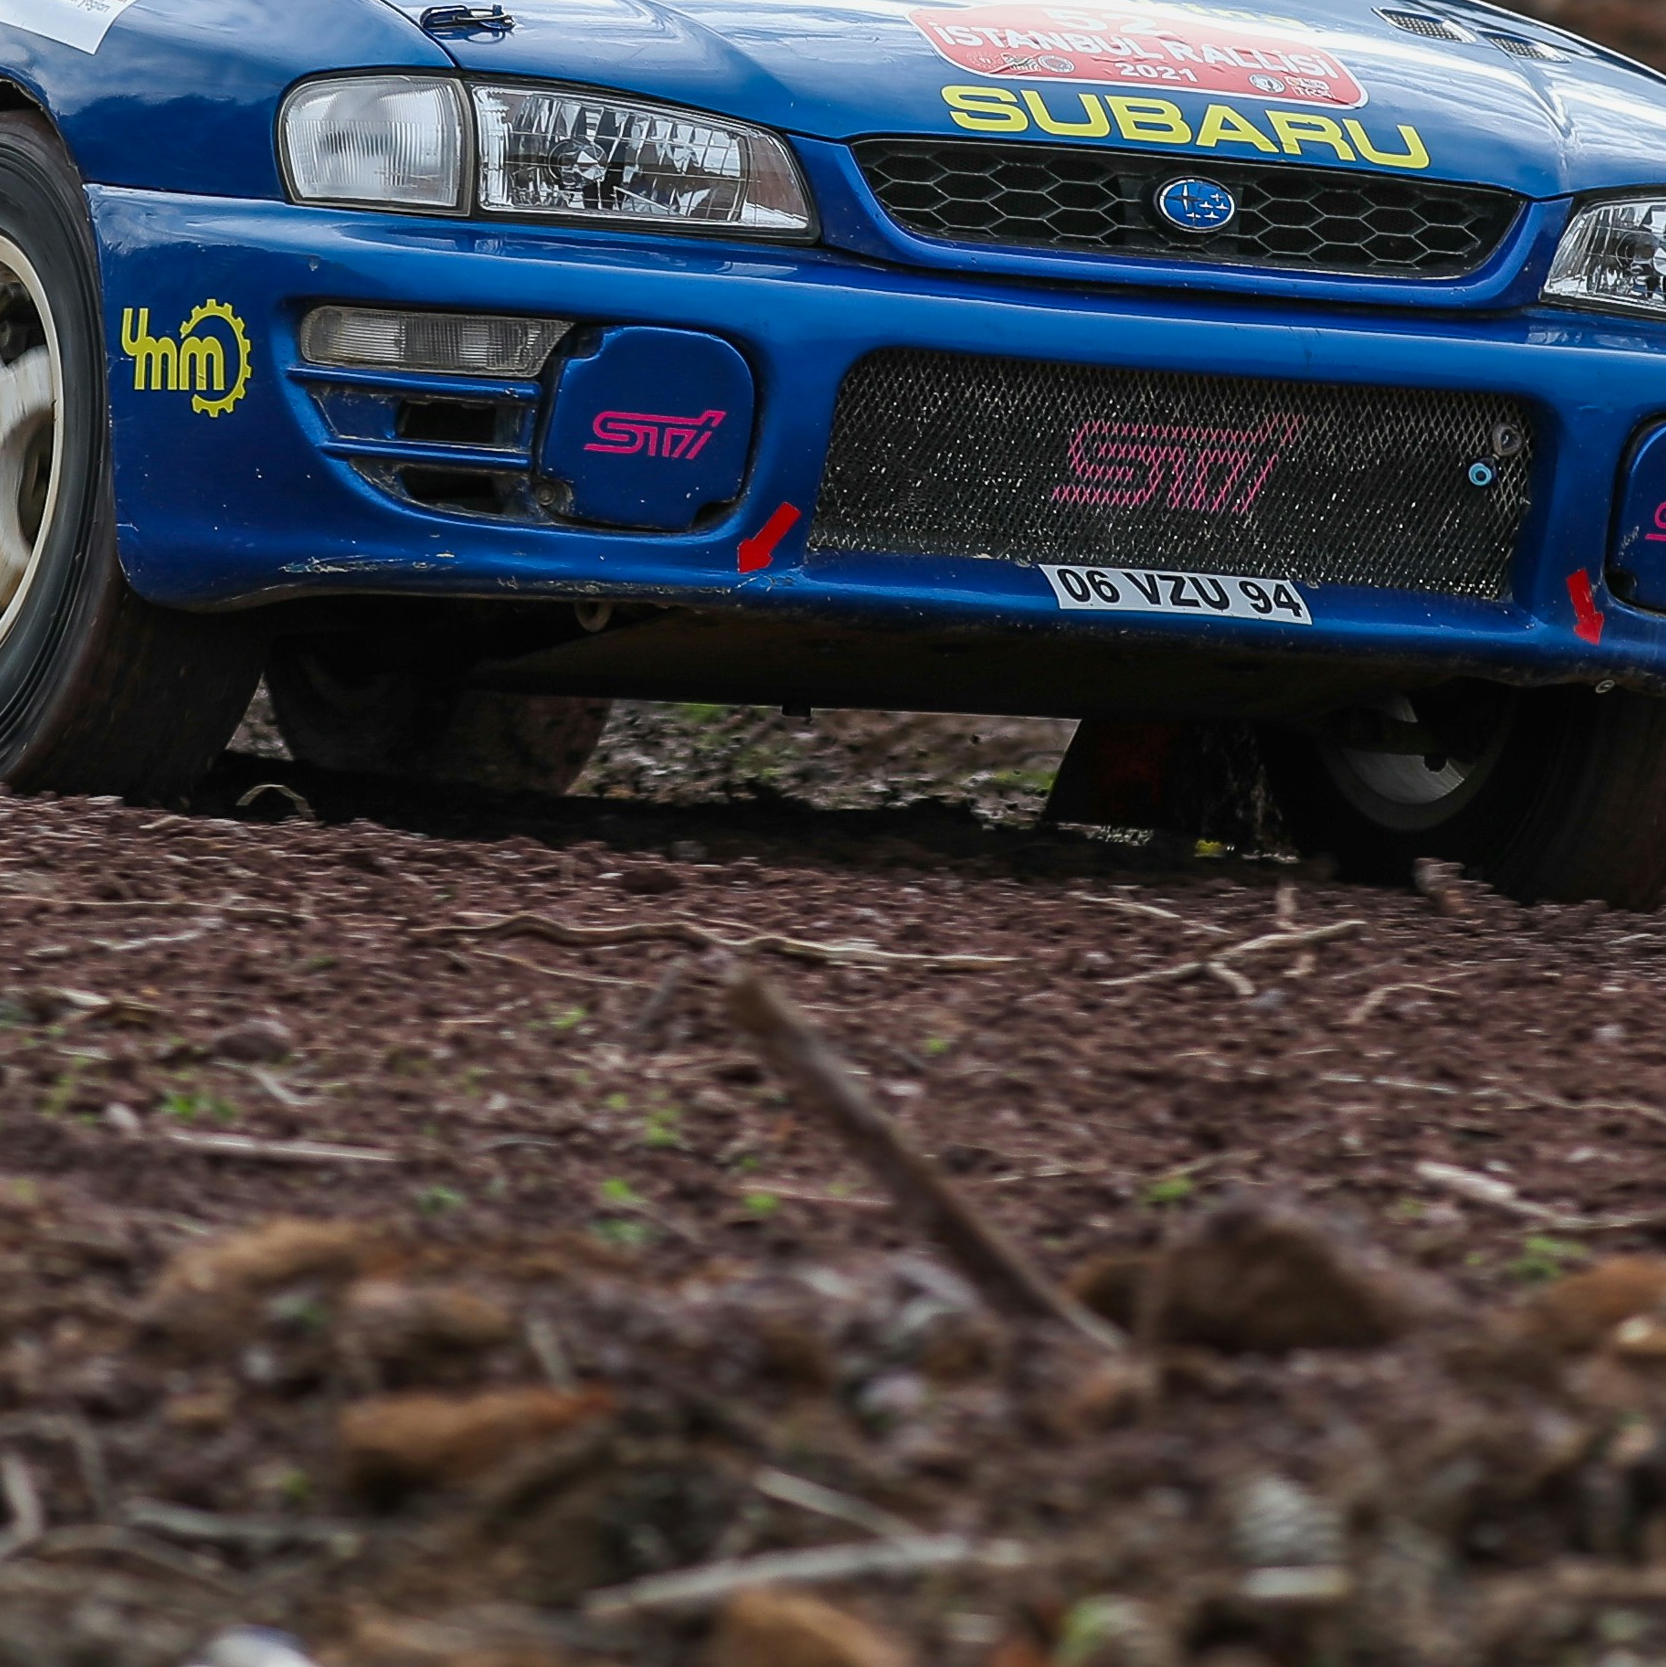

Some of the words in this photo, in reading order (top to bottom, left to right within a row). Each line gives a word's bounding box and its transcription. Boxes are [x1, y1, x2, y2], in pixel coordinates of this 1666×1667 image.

[1042, 8, 1162, 35] 52
[930, 21, 1165, 62] İSTANBUL
[1164, 36, 1339, 79] RALLİSİ
[1117, 62, 1199, 83] 2021
[940, 85, 1431, 169] SUBARU
[1057, 568, 1121, 604] 06
[1122, 571, 1230, 611] VZU
[1238, 580, 1303, 618] 94
